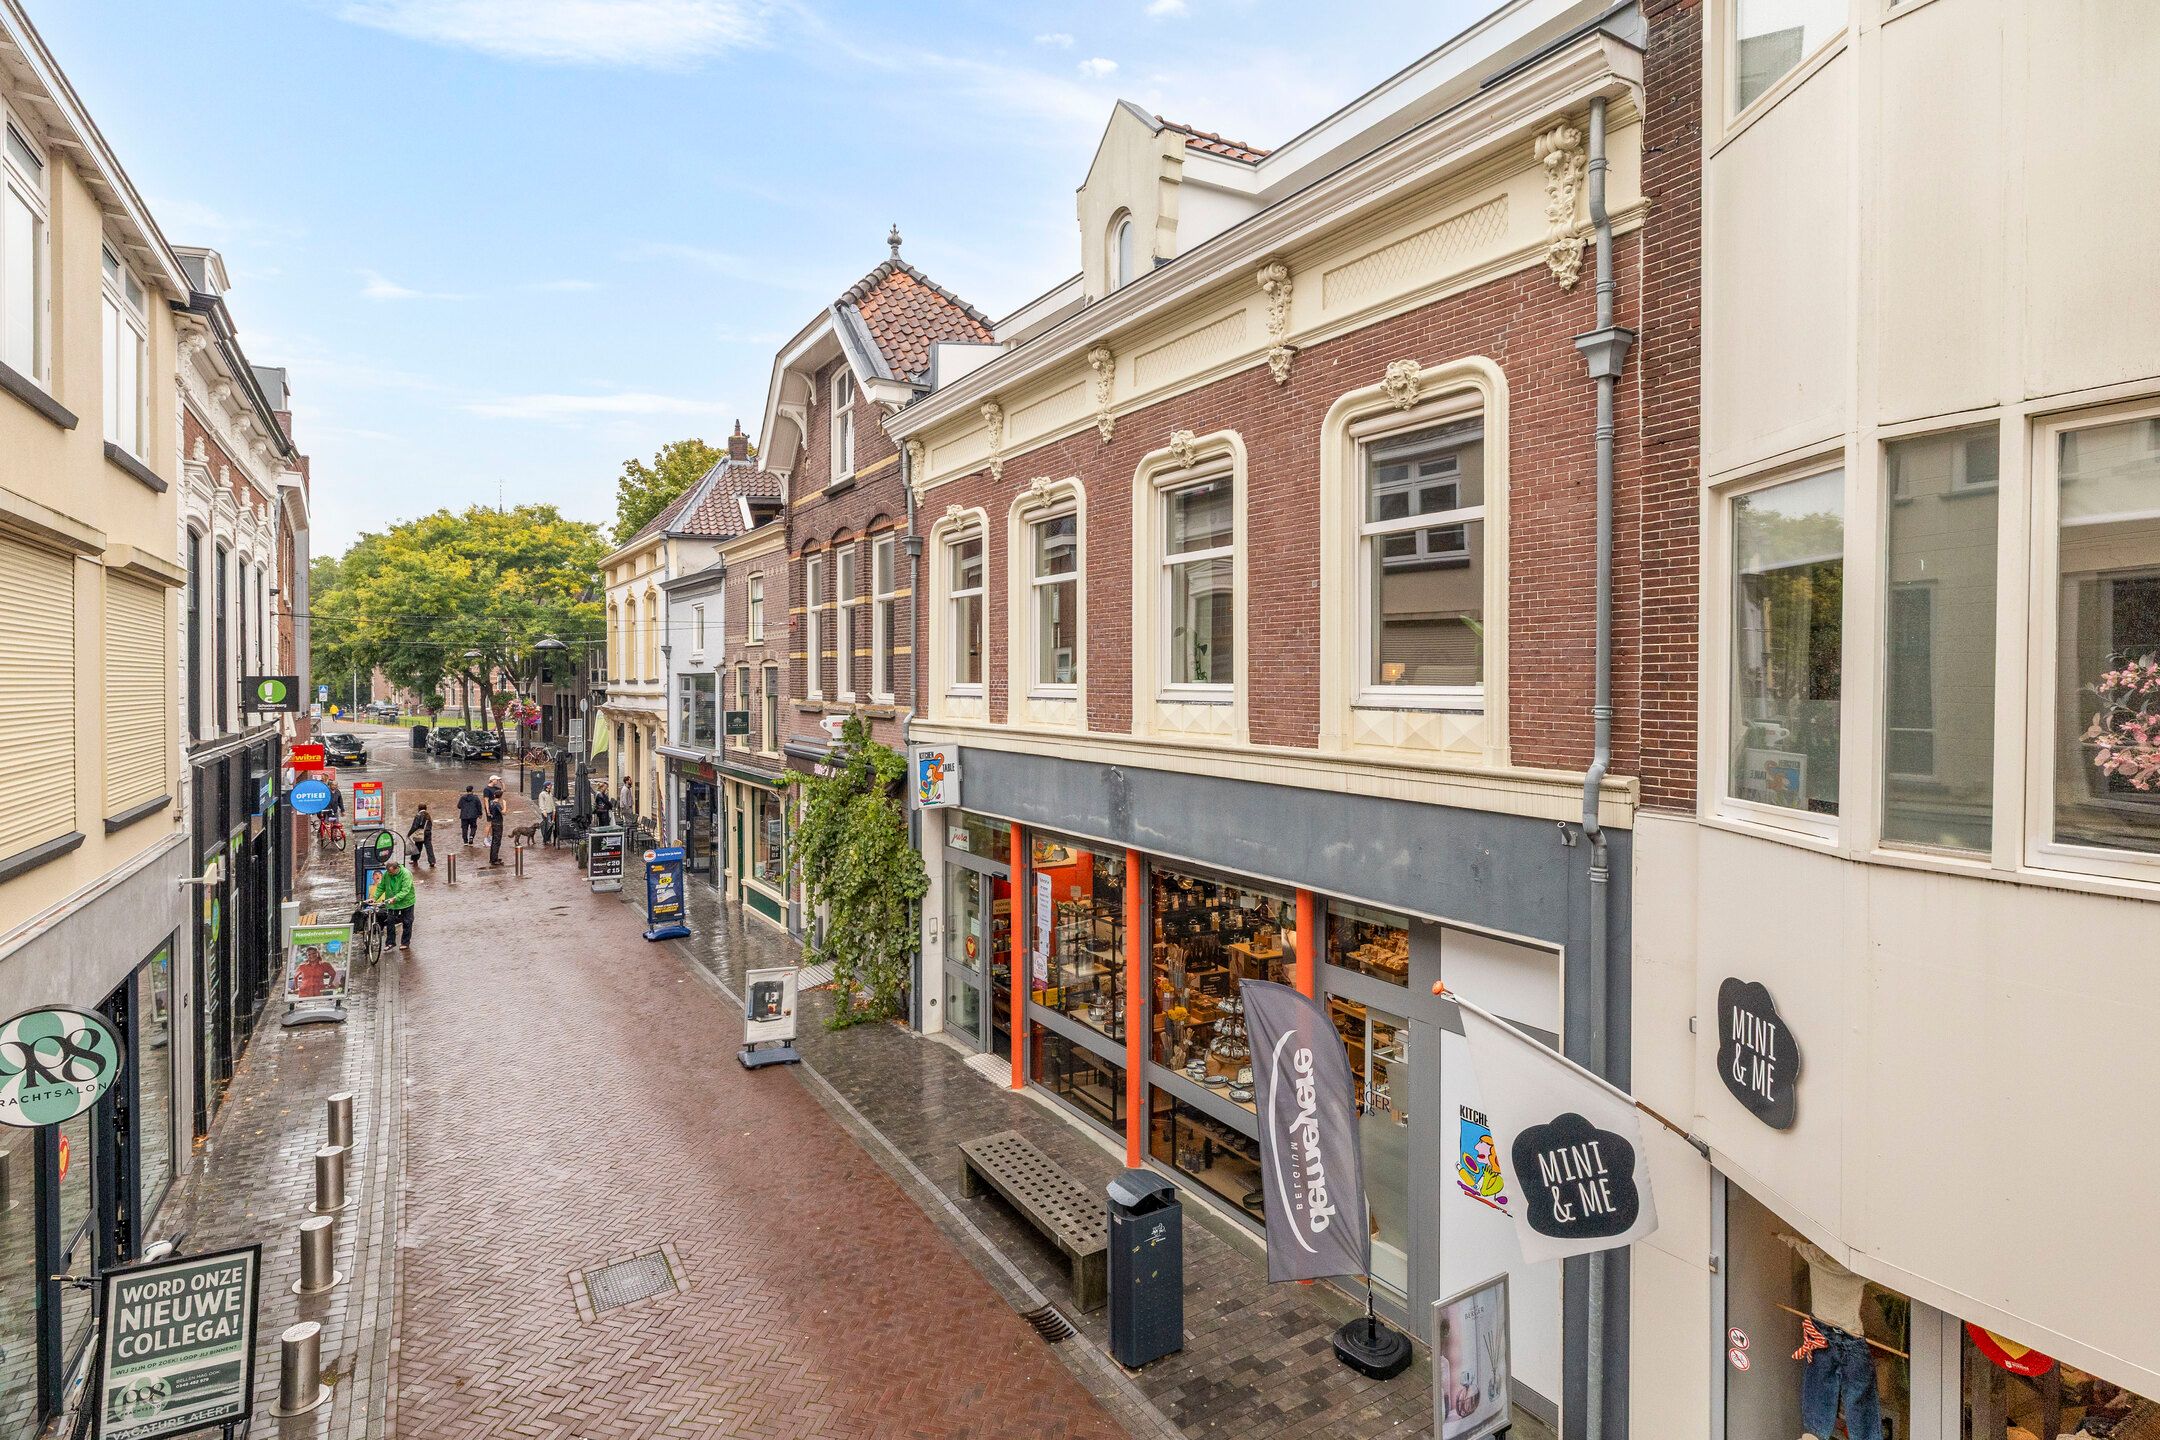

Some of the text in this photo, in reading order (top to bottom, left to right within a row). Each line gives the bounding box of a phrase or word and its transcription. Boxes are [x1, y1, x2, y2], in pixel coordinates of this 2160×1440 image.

[295, 753, 322, 762] wibra
[1732, 1005, 1777, 1062] MINI
[1732, 1042, 1775, 1102] & ME
[1537, 1141, 1608, 1187] MINI
[1551, 1178, 1617, 1222] & ME
[122, 1266, 243, 1304] WORD ONZE
[119, 1286, 242, 1334] NIEUWE
[117, 1314, 240, 1358] COLLEGA!
[115, 1368, 130, 1376] WIJ
[130, 1364, 146, 1373] ZIJN
[147, 1361, 157, 1369] OP
[179, 1353, 198, 1362] LOOP
[209, 1344, 238, 1355] BINNEN?
[112, 1405, 232, 1440] VACATURE ALERT
